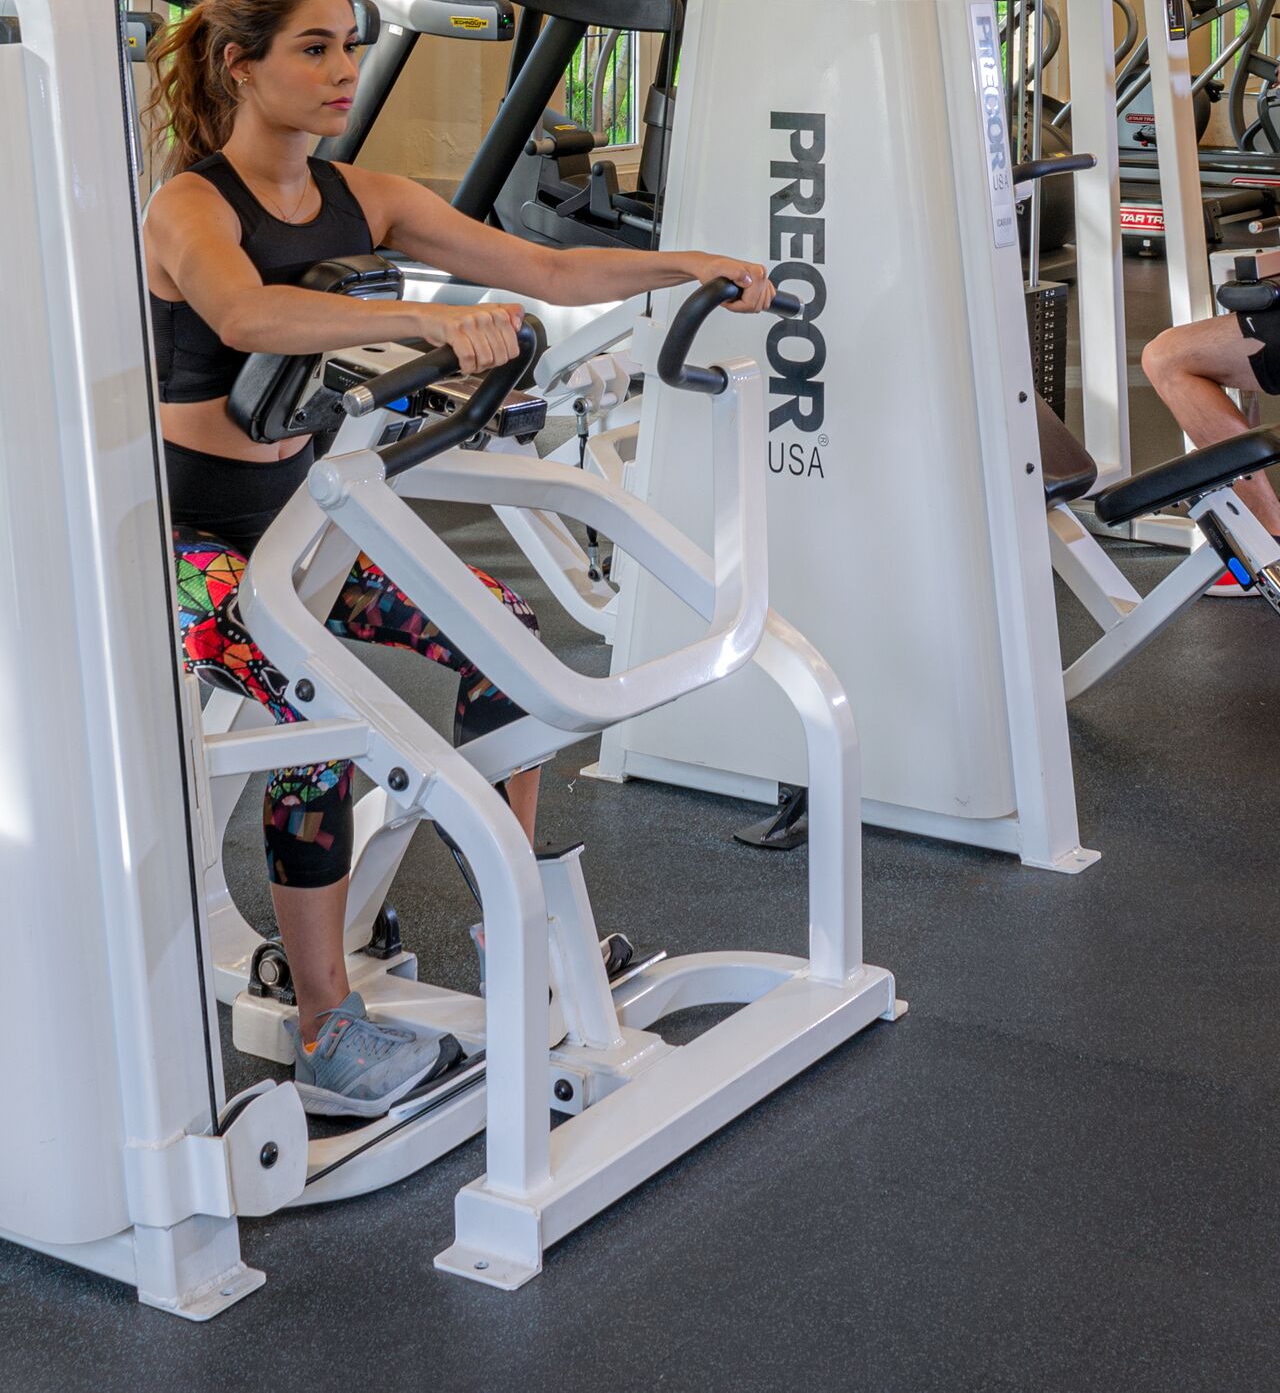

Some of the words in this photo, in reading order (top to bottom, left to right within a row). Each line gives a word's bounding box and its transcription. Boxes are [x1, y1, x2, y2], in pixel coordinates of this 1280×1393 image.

[976, 16, 1005, 173] PRECOR
[992, 173, 1010, 191] USA
[1120, 213, 1145, 223] TAR
[766, 111, 827, 434] PRECOR
[767, 440, 825, 479] USA
